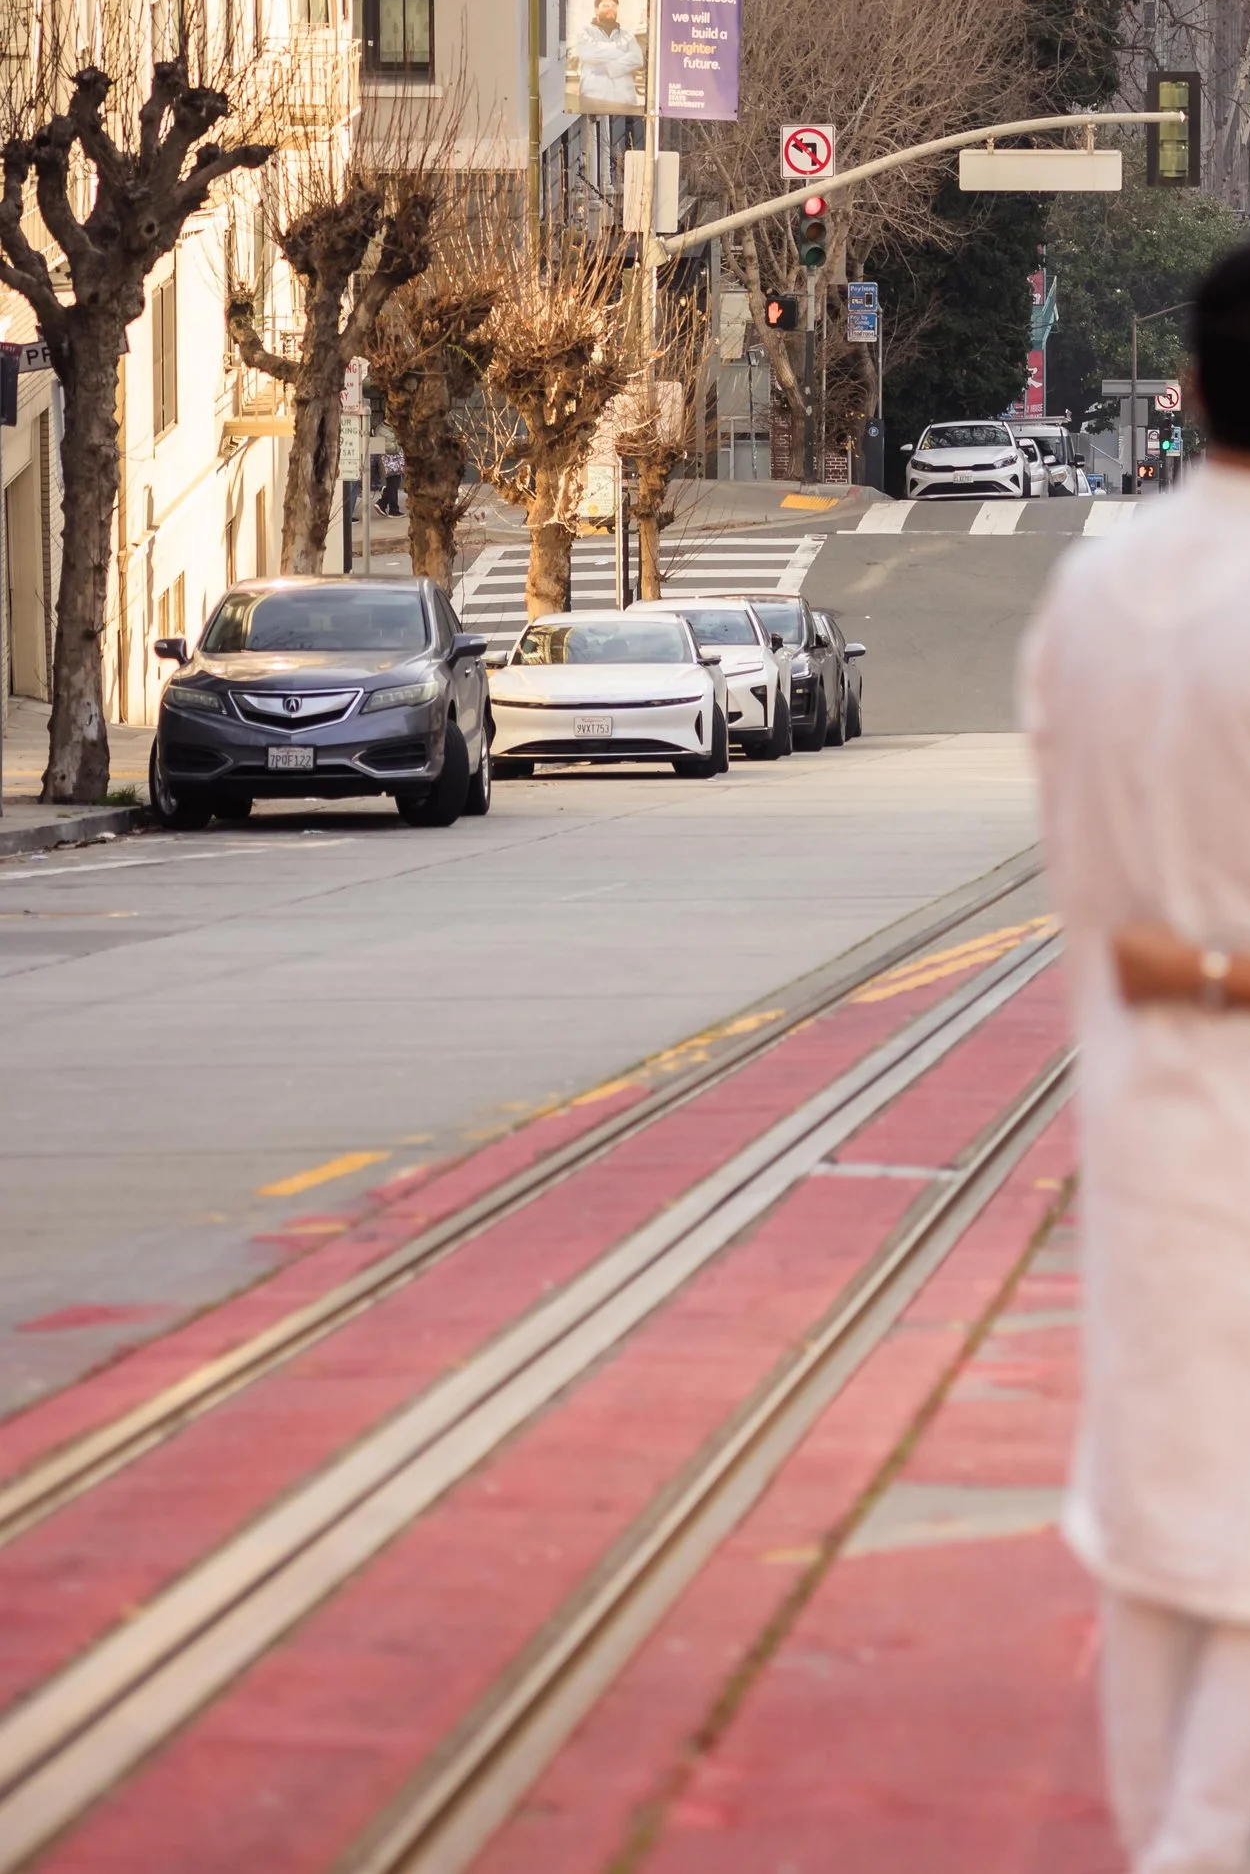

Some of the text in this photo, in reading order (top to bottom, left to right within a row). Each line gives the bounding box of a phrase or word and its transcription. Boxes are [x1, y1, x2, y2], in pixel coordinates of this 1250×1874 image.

[671, 11, 711, 24] we will
[691, 26, 728, 40] build a
[671, 40, 717, 56] brighter
[683, 56, 721, 70] future.
[576, 724, 610, 734] 9VXT753
